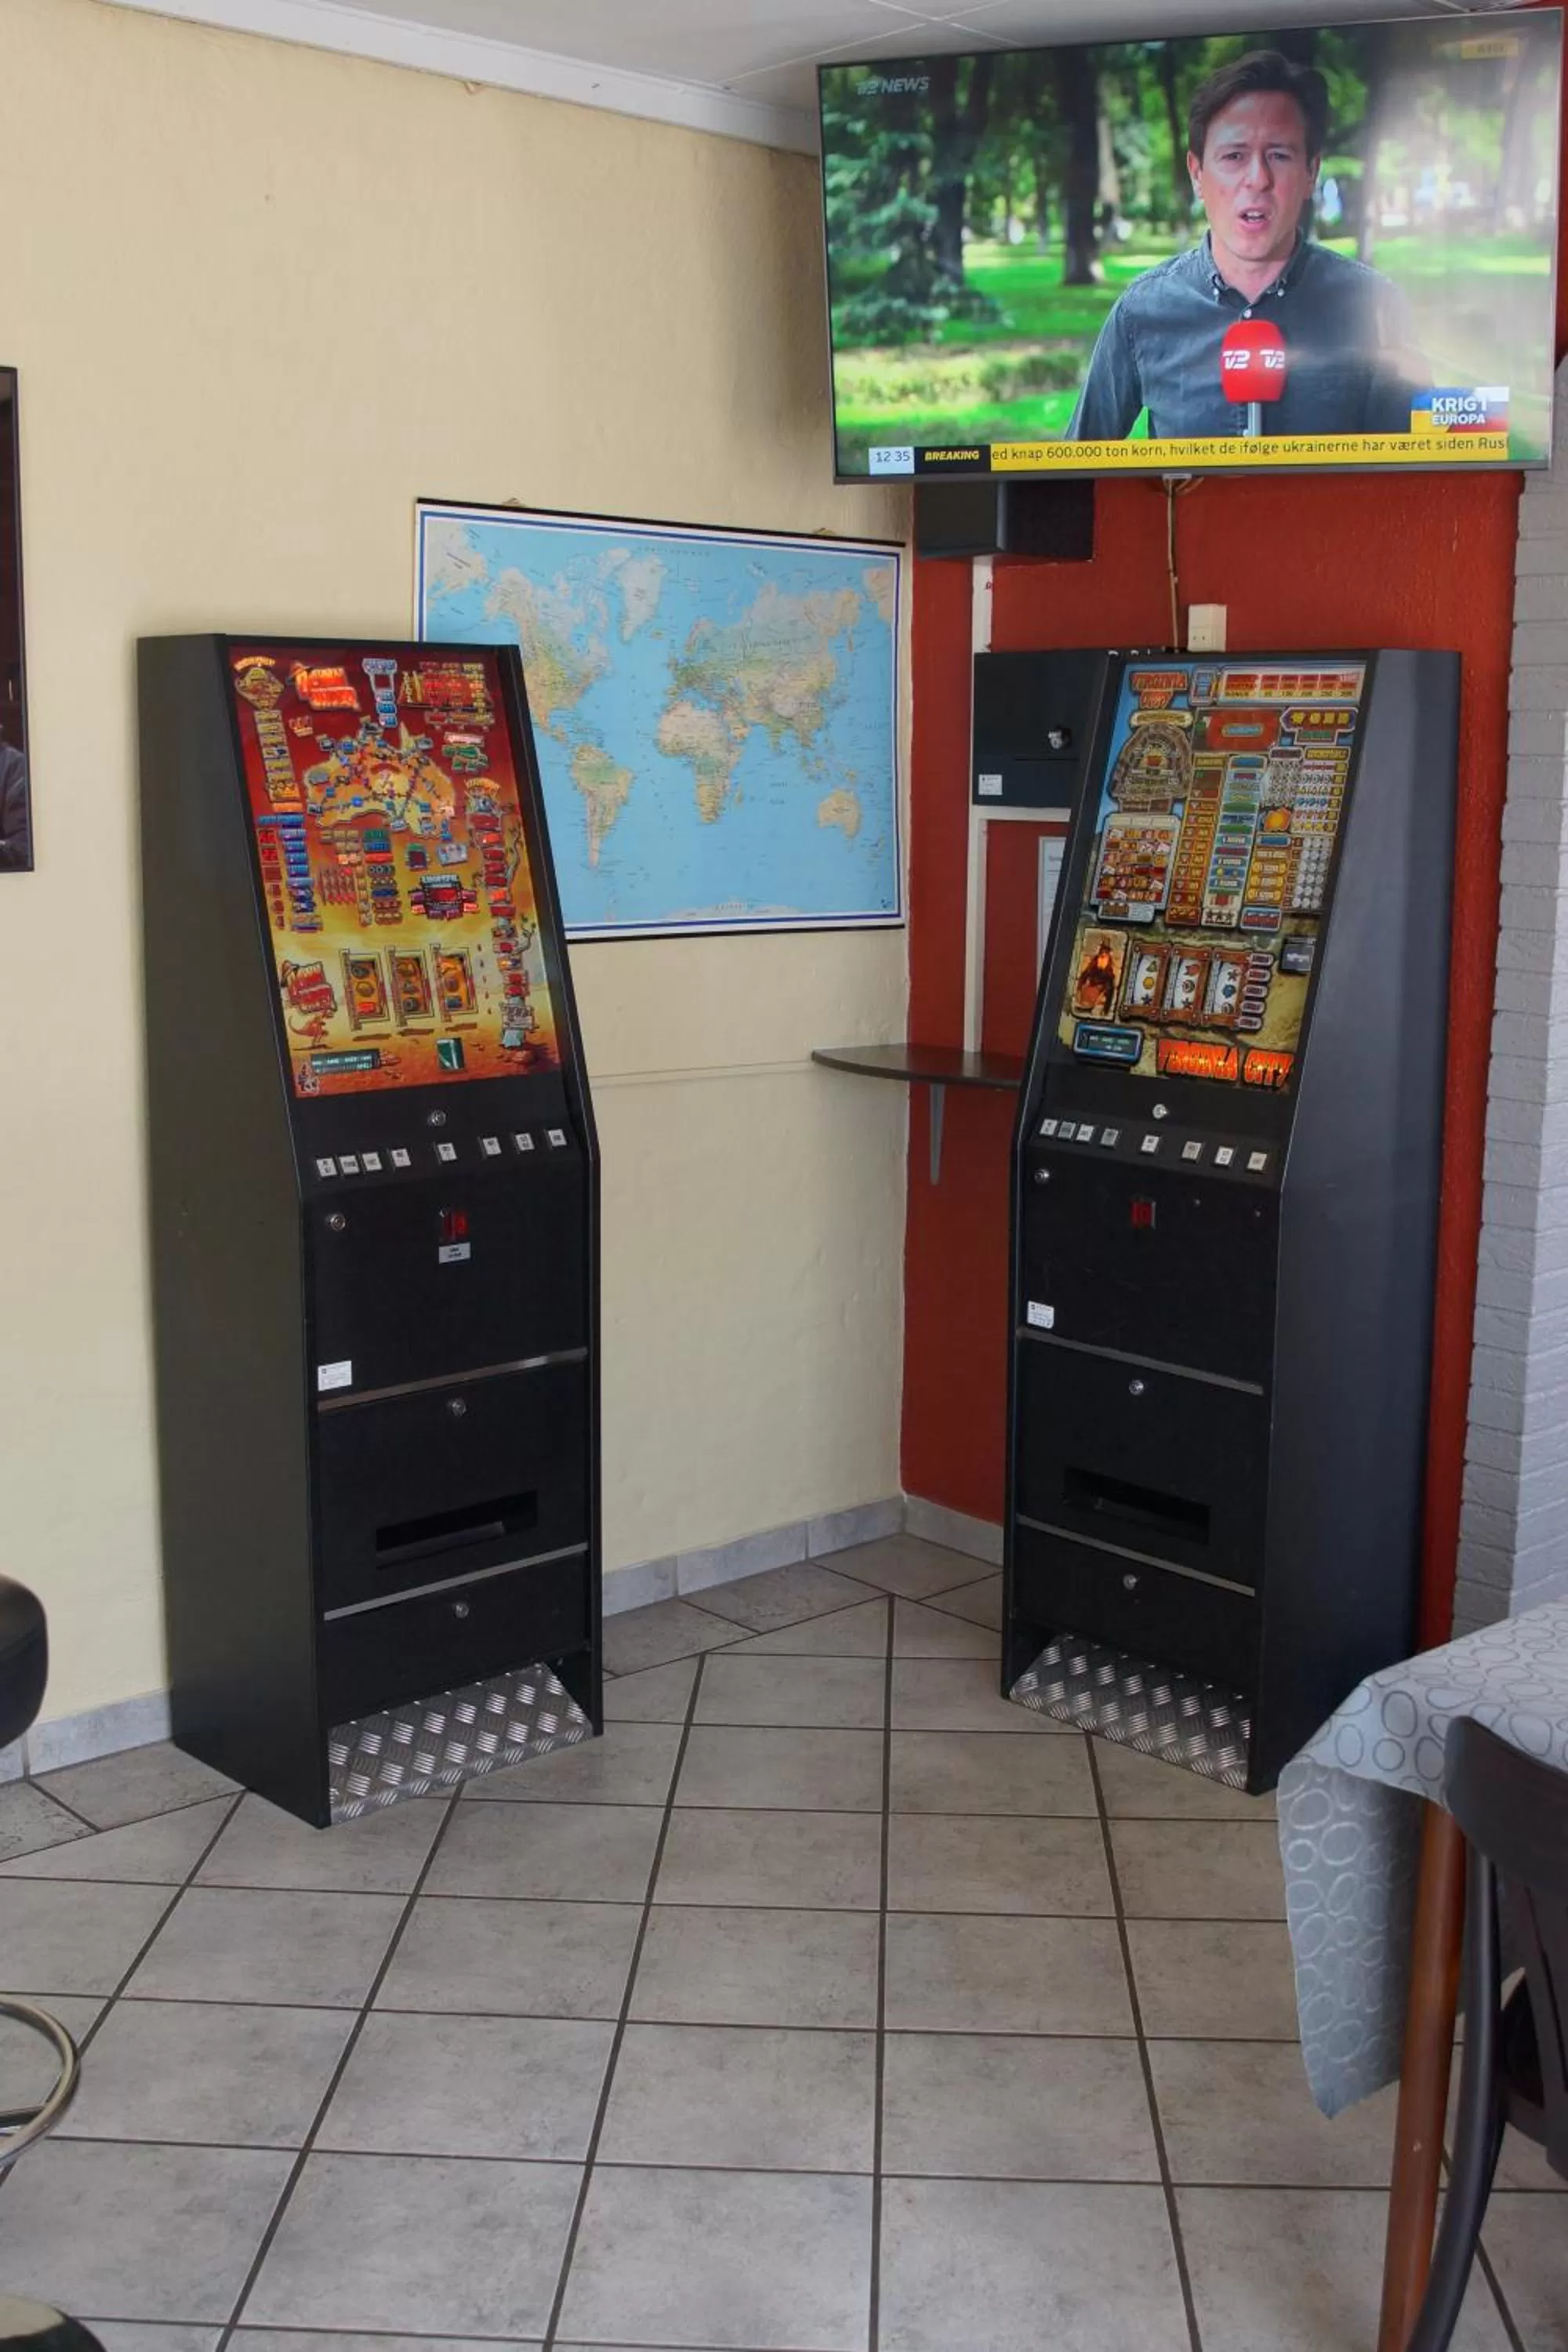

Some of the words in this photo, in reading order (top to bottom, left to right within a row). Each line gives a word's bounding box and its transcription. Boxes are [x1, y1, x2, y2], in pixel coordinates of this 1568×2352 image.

[880, 76, 930, 93] NEWS
[1432, 396, 1477, 412] KRIG
[1432, 413, 1486, 426] EUROPA
[895, 450, 911, 463] 35
[924, 450, 980, 462] BREAKING
[992, 448, 1008, 460] ed
[1011, 448, 1044, 462] knap
[1047, 445, 1102, 460] 600.000
[1105, 445, 1129, 457] ton
[1131, 444, 1166, 458] korn,
[1170, 442, 1215, 456] hvilket
[1219, 441, 1236, 455] de
[1240, 441, 1279, 456] ifølge
[1283, 439, 1358, 454] ukrainerne
[1362, 438, 1386, 452] har
[1390, 439, 1432, 452] været
[1436, 437, 1475, 451] siden
